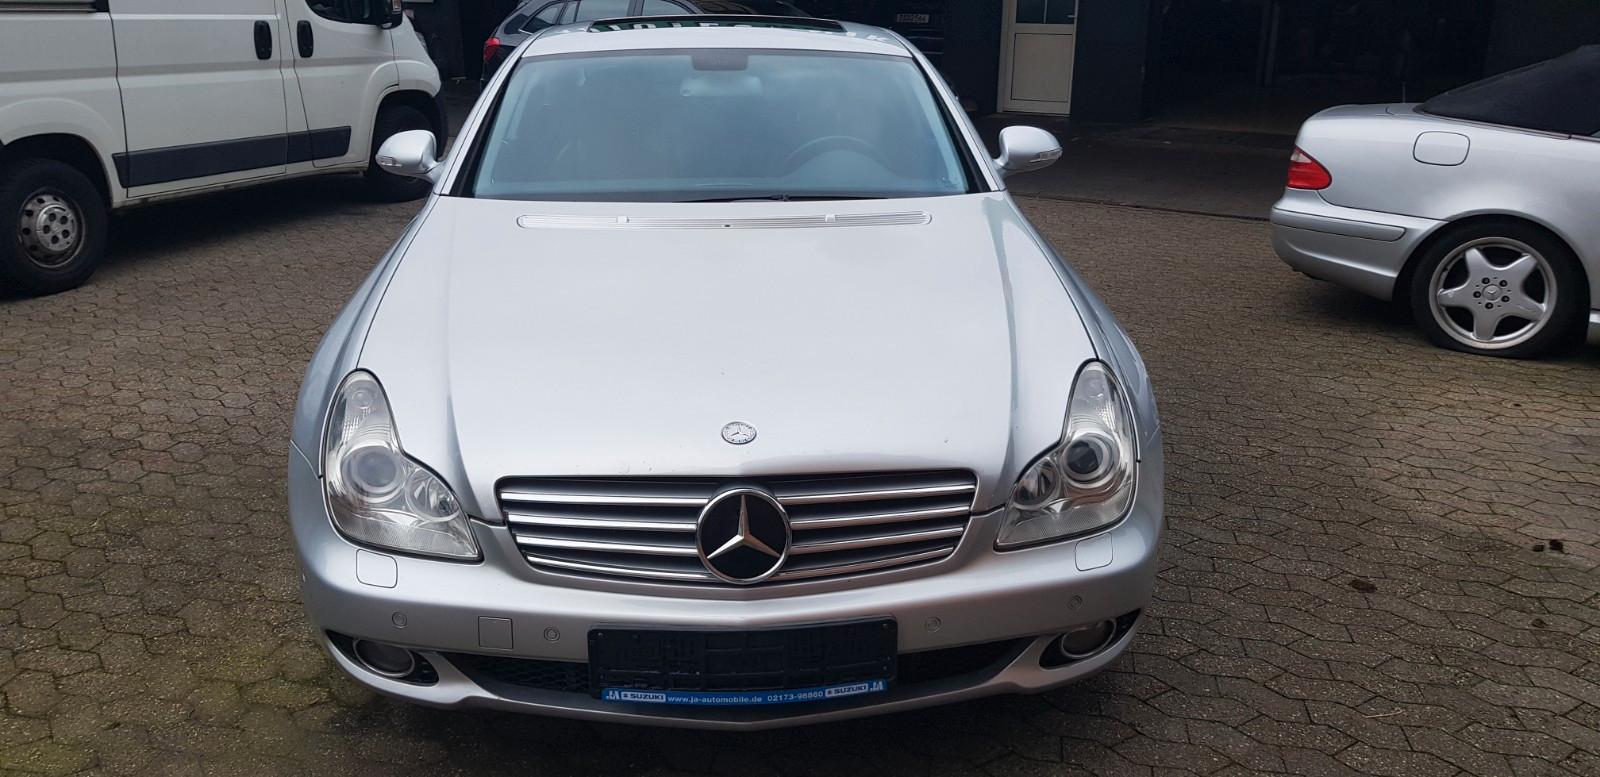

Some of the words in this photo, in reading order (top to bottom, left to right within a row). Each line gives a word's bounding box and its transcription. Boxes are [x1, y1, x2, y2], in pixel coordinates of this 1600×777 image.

[630, 693, 664, 701] SUZUKI
[667, 695, 763, 704] www.ja-automobile.de
[834, 685, 867, 695] SUZUKI
